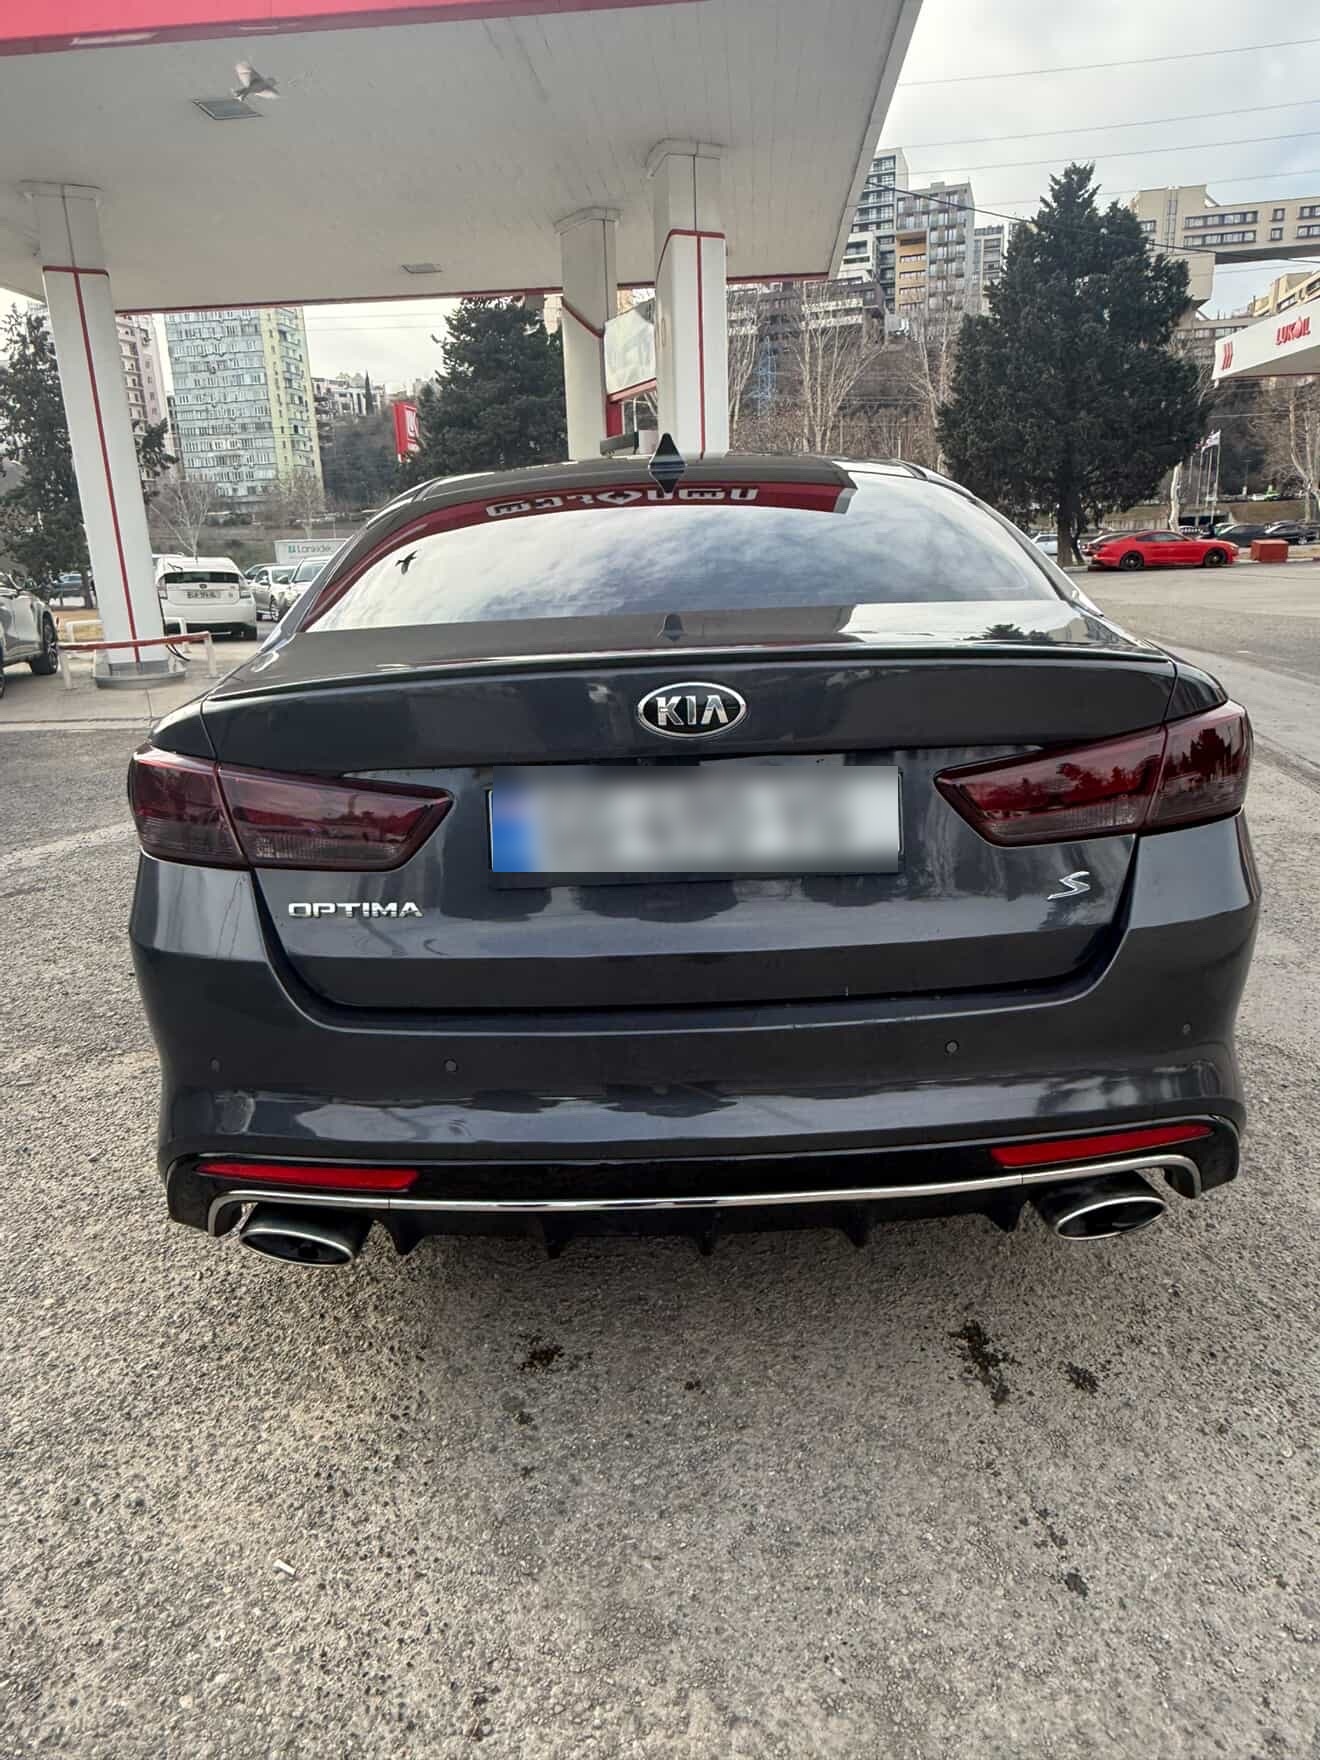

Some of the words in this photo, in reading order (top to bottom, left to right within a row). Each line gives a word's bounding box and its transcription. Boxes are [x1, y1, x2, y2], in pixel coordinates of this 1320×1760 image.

[1275, 316, 1311, 345] LUKOIL
[655, 695, 729, 726] KIA
[1047, 871, 1091, 900] S
[288, 902, 424, 918] OPTIMA
